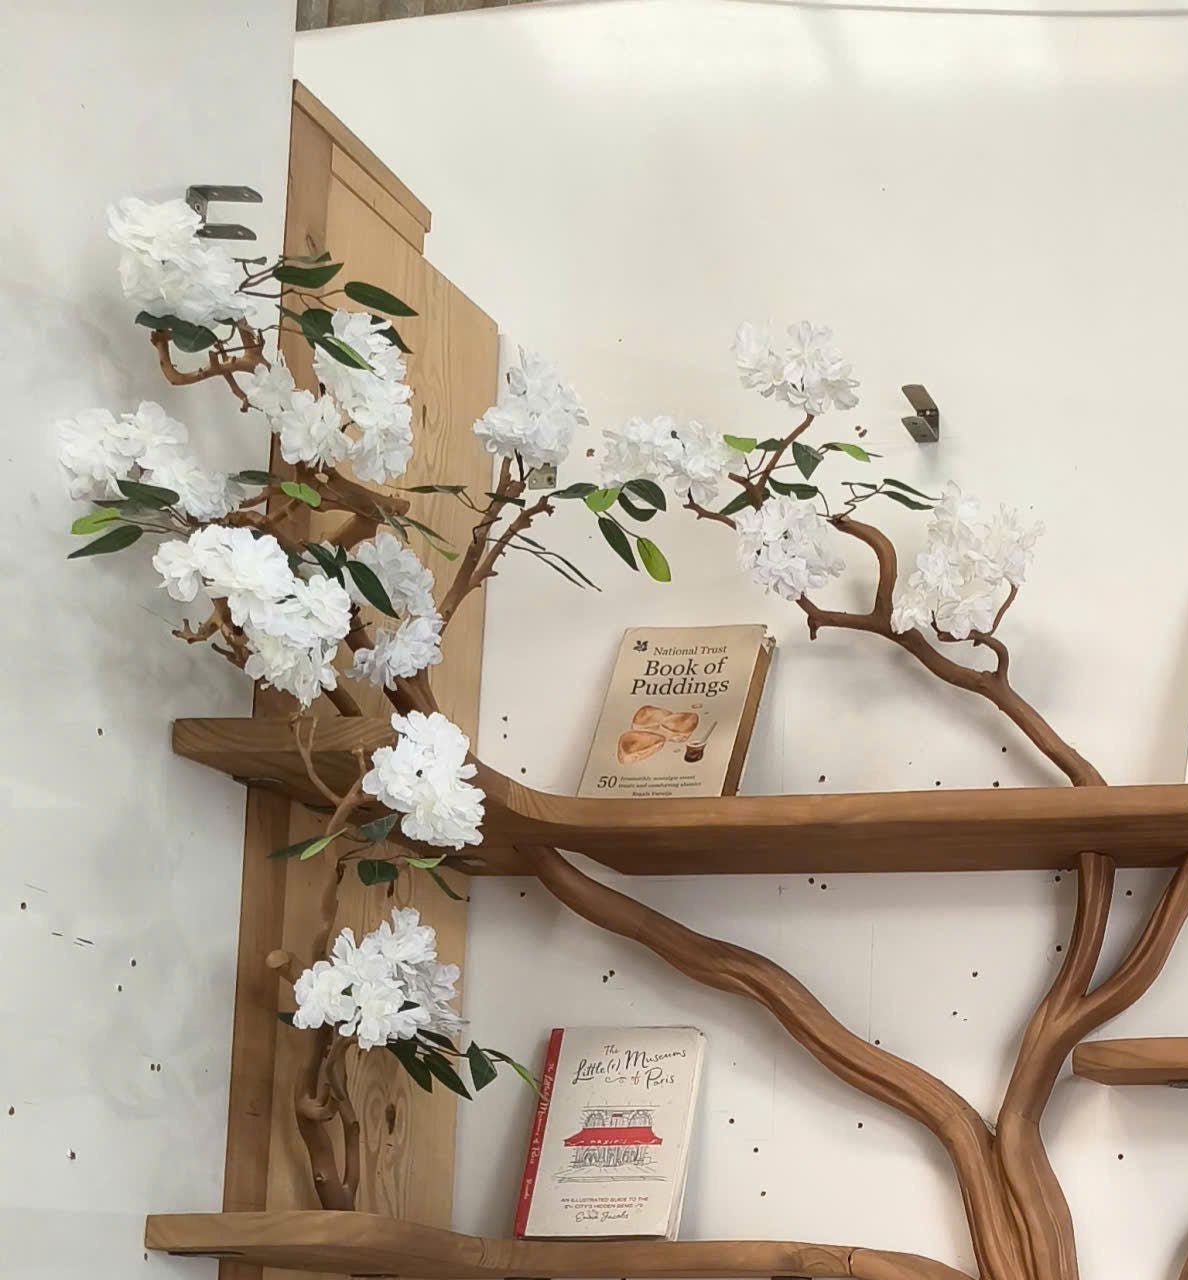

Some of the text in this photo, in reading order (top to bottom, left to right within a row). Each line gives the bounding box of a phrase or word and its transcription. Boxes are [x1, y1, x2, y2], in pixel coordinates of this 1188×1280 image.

[653, 645, 728, 657] National Trust
[643, 656, 729, 676] Book of
[630, 677, 730, 698] Puddings
[597, 775, 618, 789] 50
[604, 1045, 619, 1056] The
[625, 1049, 687, 1069] Museums
[631, 1067, 675, 1089] of Paris
